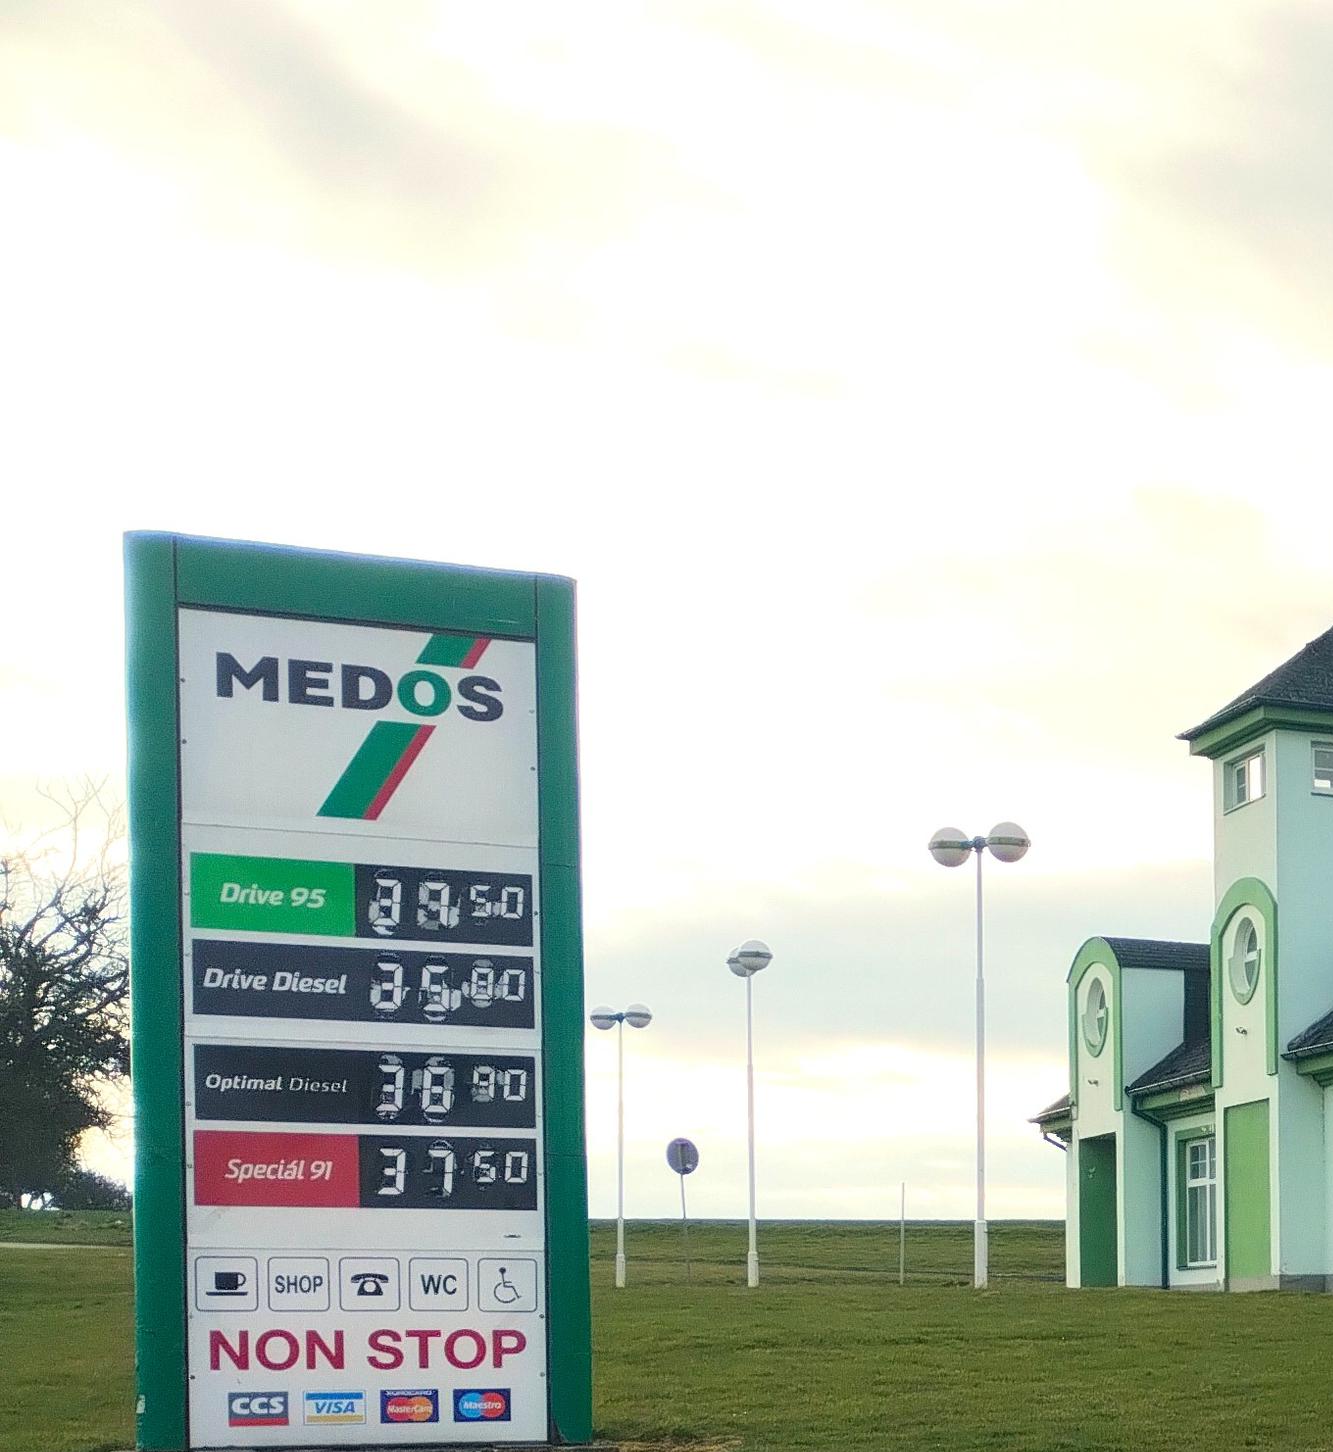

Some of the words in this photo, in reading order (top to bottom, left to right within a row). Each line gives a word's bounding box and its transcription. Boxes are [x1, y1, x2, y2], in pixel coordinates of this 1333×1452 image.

[215, 651, 505, 723] MEDOS
[219, 882, 285, 906] Drive
[290, 887, 327, 909] 95
[203, 967, 268, 991] Drive
[272, 971, 348, 994] Diesel
[205, 1073, 283, 1092] Optimal
[289, 1077, 351, 1093] Diesel
[225, 1158, 306, 1184] Speciál
[310, 1160, 333, 1181] 91
[274, 1274, 324, 1294] SHOP
[420, 1274, 458, 1295] WC
[209, 1330, 345, 1371] NON
[366, 1329, 527, 1370] STOP
[231, 1396, 284, 1416] CCS
[314, 1400, 356, 1415] VISA
[463, 1401, 501, 1411] Maestro
